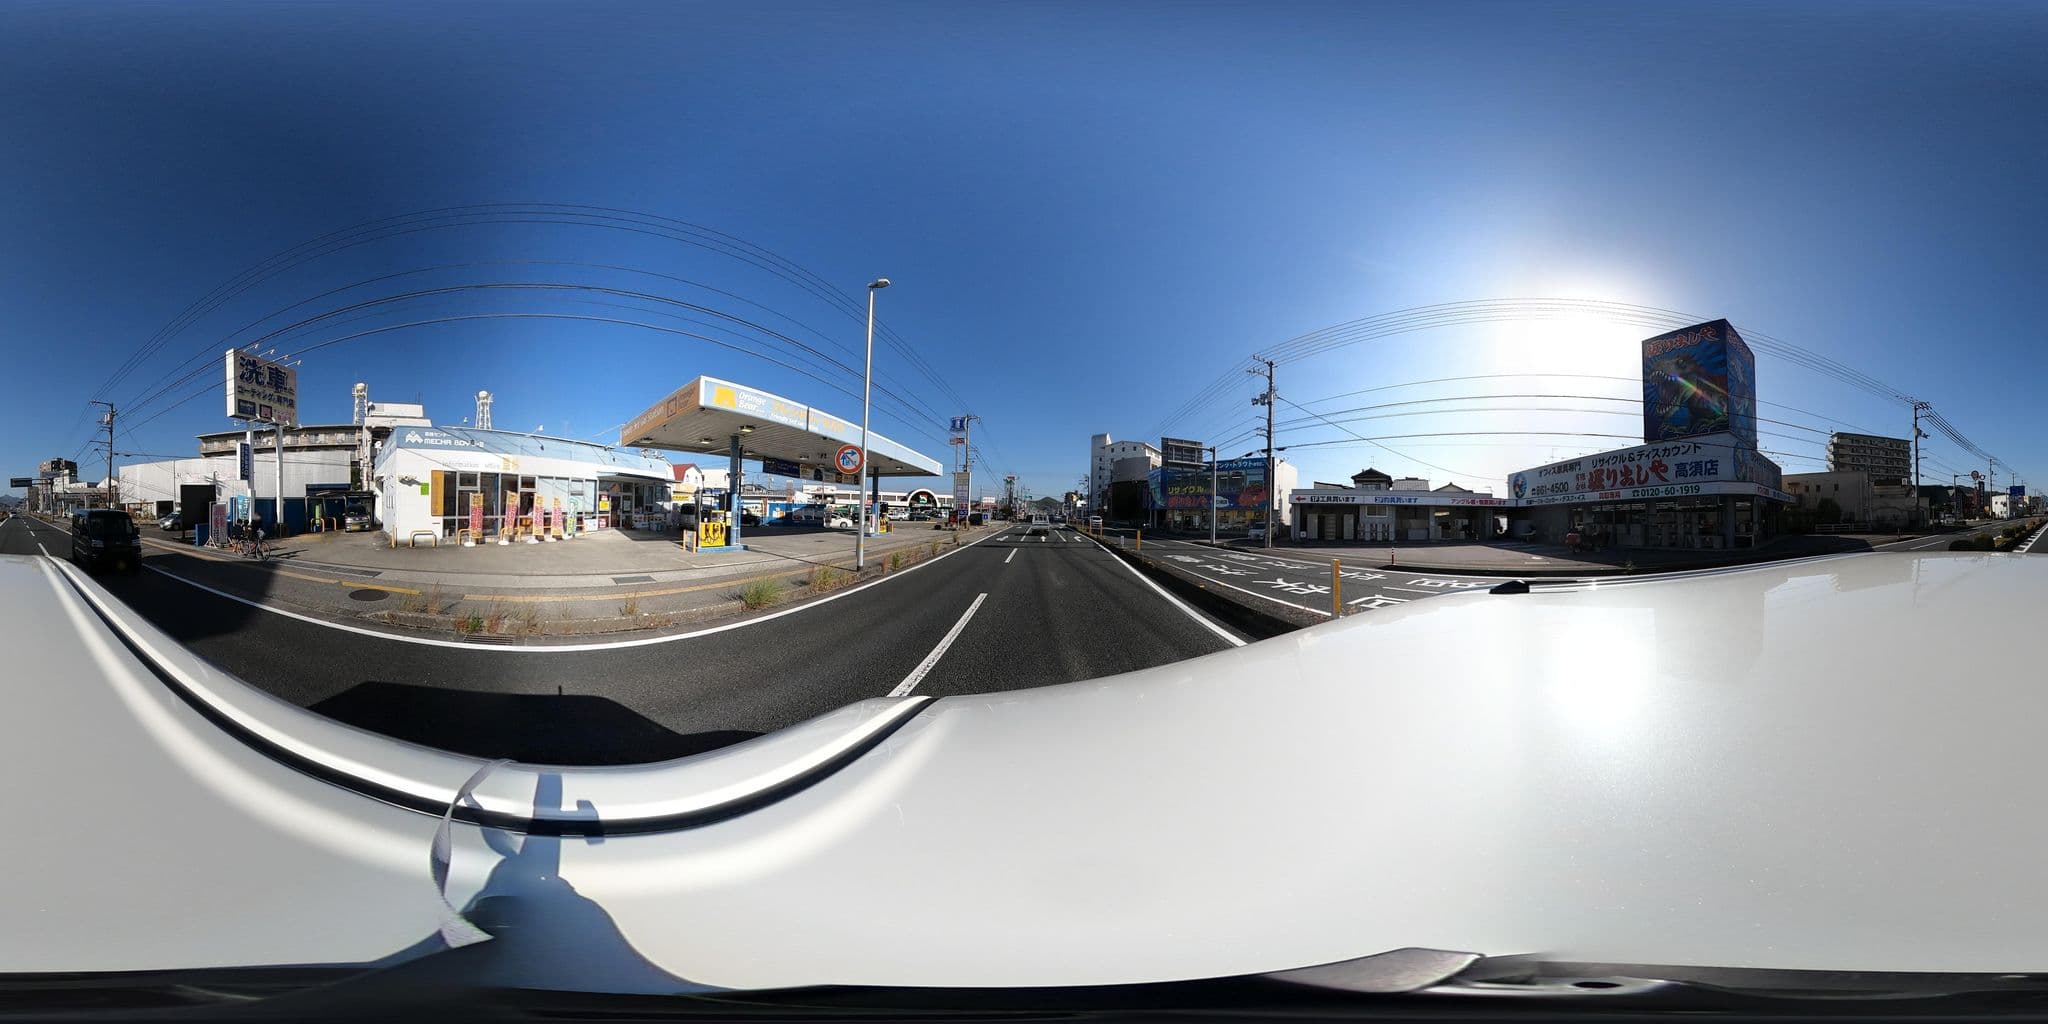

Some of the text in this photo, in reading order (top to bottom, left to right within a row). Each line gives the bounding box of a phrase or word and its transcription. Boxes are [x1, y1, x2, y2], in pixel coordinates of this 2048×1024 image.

[738, 391, 768, 406] Orange
[424, 438, 452, 446] MECHA
[1675, 459, 1719, 479] 高須店
